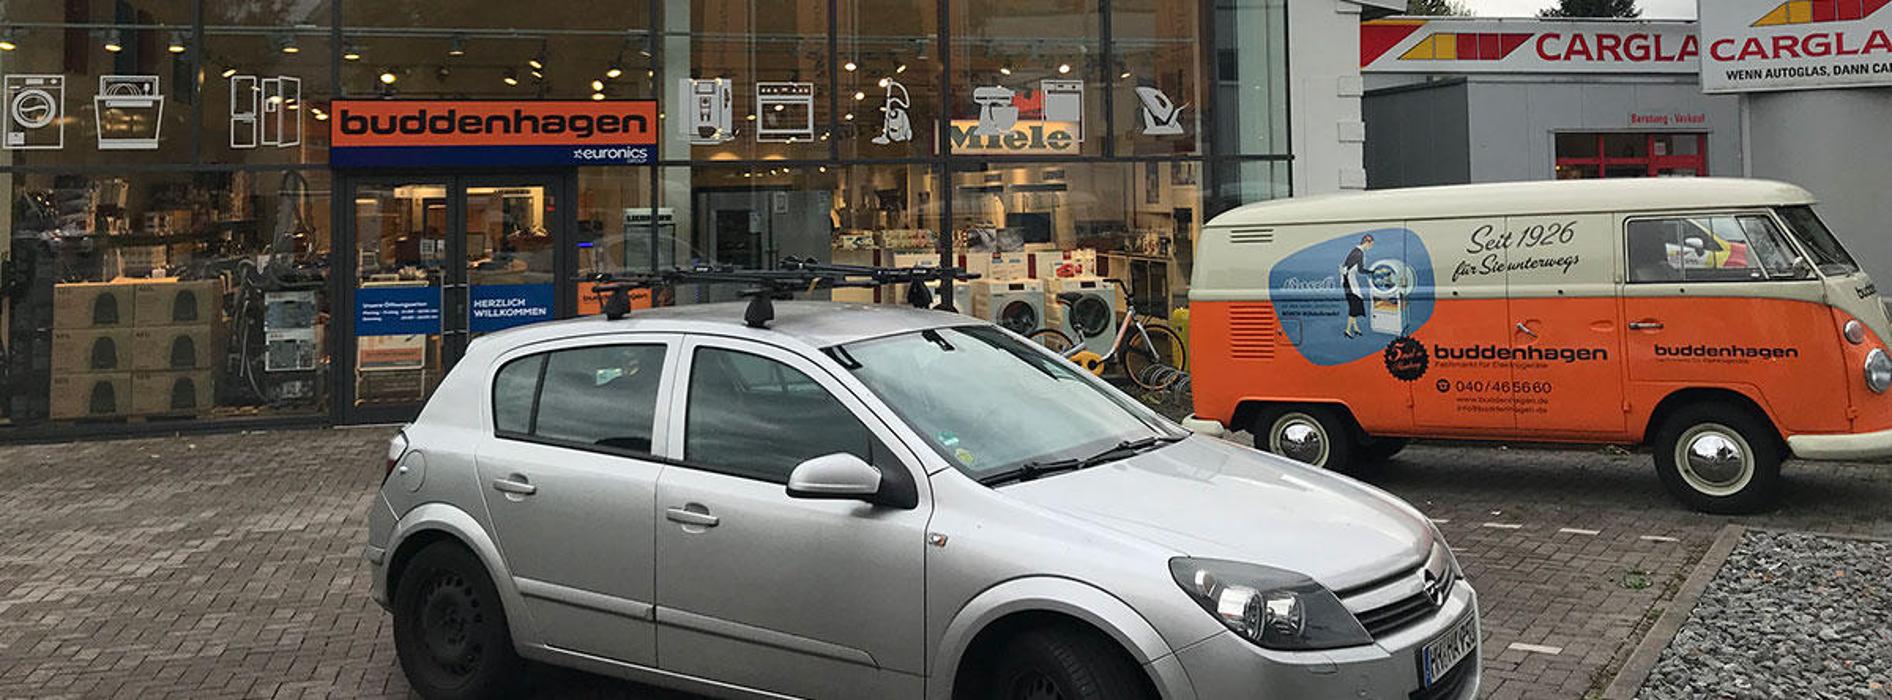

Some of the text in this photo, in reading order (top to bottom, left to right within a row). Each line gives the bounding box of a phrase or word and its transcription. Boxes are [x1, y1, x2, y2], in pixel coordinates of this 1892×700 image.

[1536, 33, 1698, 61] CARGLA
[1710, 29, 1892, 62] CARGLA
[1726, 69, 1762, 80] WENN
[1765, 66, 1830, 79] AUTOGLAS,
[1834, 63, 1868, 76] DANN
[340, 109, 647, 138] buddenhagen
[583, 146, 648, 159] euronics
[1466, 220, 1577, 254] Seit 1926
[1452, 253, 1579, 282] für Sie unterwegs
[474, 298, 526, 308] HERZLICH
[473, 307, 547, 318] WILLKOMMEN
[1434, 344, 1607, 362] buddenhagen
[1654, 344, 1799, 359] buddenhagen
